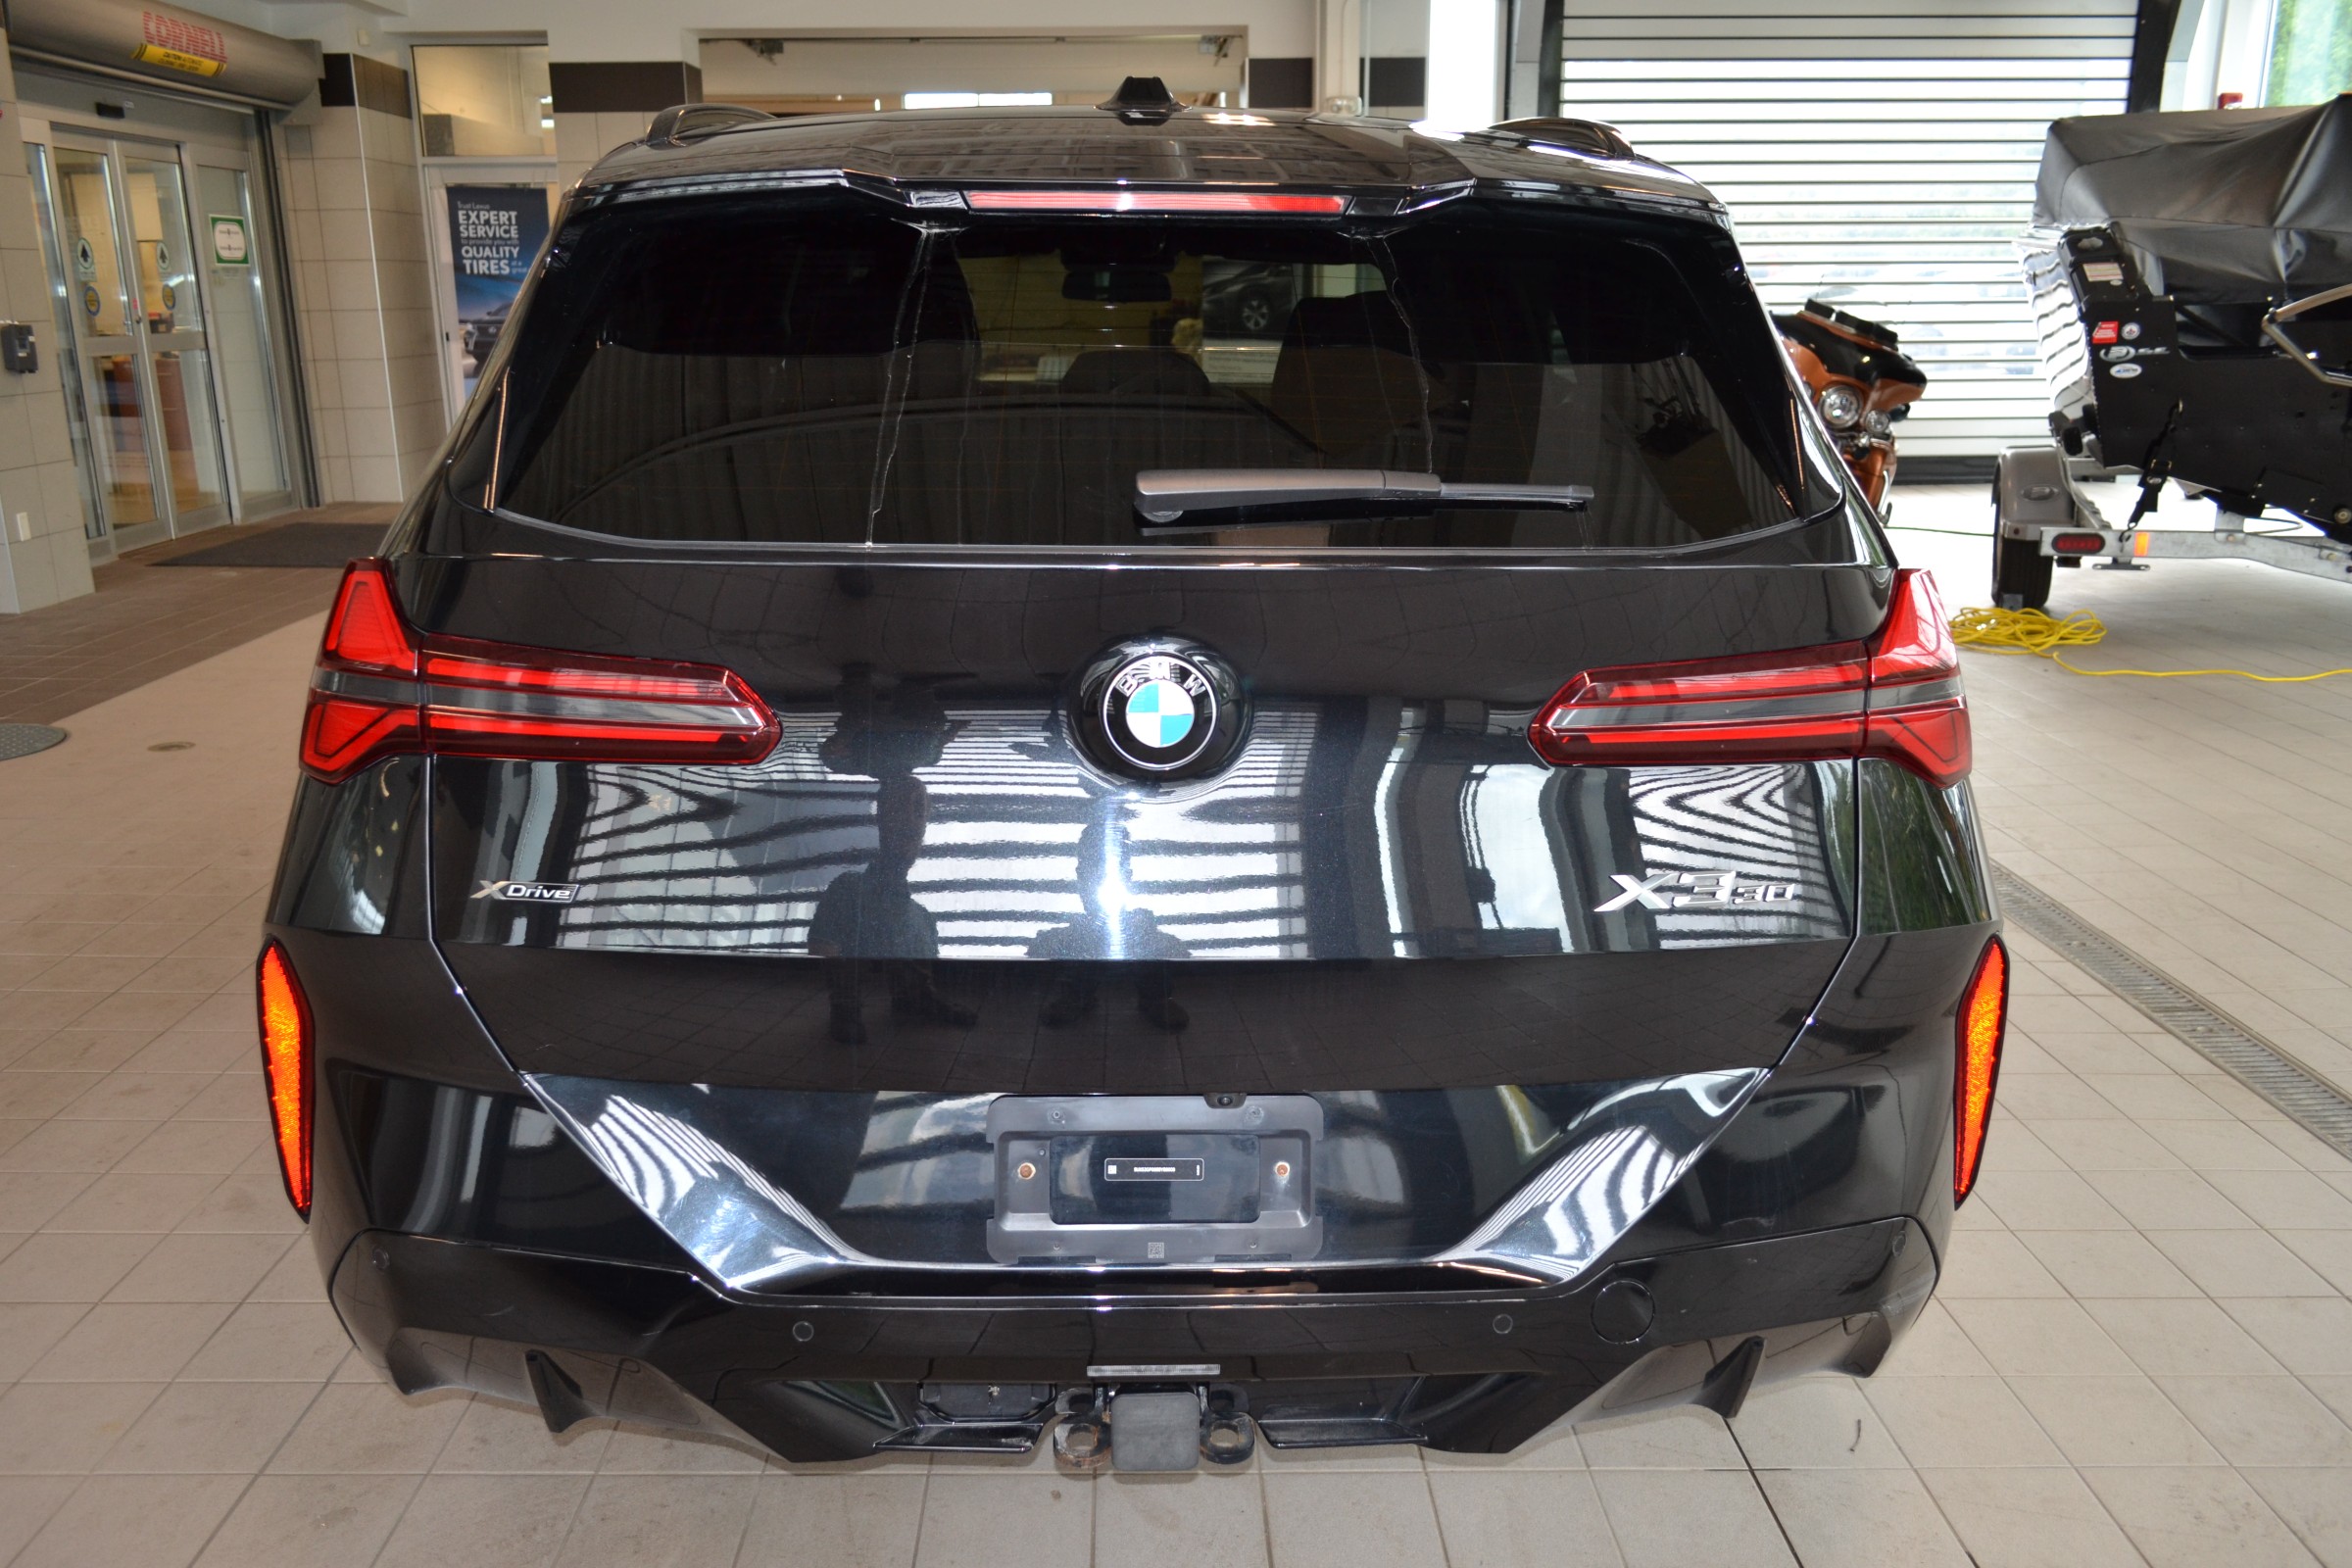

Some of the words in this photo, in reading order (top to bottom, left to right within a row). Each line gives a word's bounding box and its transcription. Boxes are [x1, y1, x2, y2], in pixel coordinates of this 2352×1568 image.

[143, 11, 227, 63] CORNELL
[458, 210, 517, 225] EXPERT
[460, 224, 518, 238] SERVICE
[462, 245, 519, 259] QUALITY
[463, 259, 510, 275] TIRES
[1116, 662, 1205, 697] BMW
